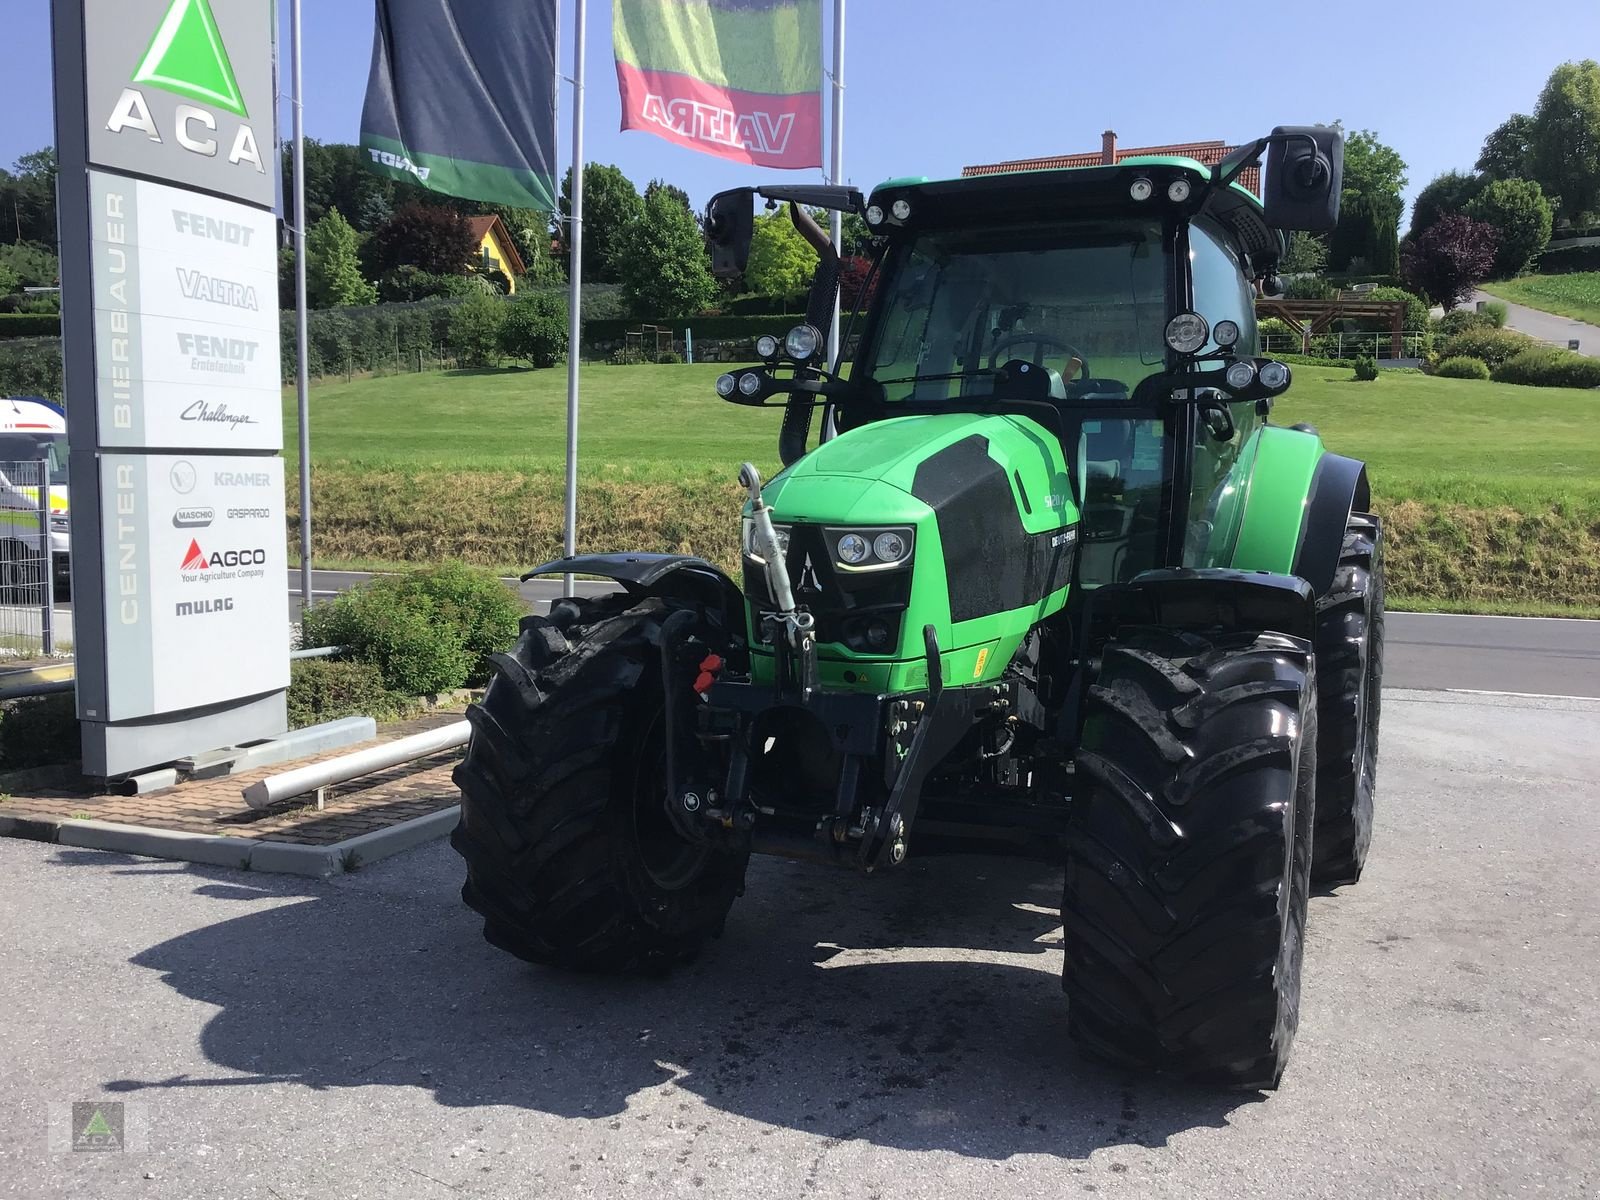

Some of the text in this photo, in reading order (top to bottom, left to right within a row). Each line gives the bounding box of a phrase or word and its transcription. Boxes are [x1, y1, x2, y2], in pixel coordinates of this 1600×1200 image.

[105, 87, 265, 174] ACA
[171, 209, 255, 247] FENDT
[175, 267, 259, 312] VALTRA
[106, 192, 132, 428] BIERBAUER
[176, 332, 259, 362] FENDT
[180, 400, 260, 431] Challenger
[214, 471, 271, 487] KRAMER
[178, 510, 213, 520] MASCHIO
[227, 508, 270, 519] GASPARDO
[116, 464, 138, 625] CENTER
[209, 549, 266, 568] AGCO
[181, 568, 265, 584] Your Agriculture Company
